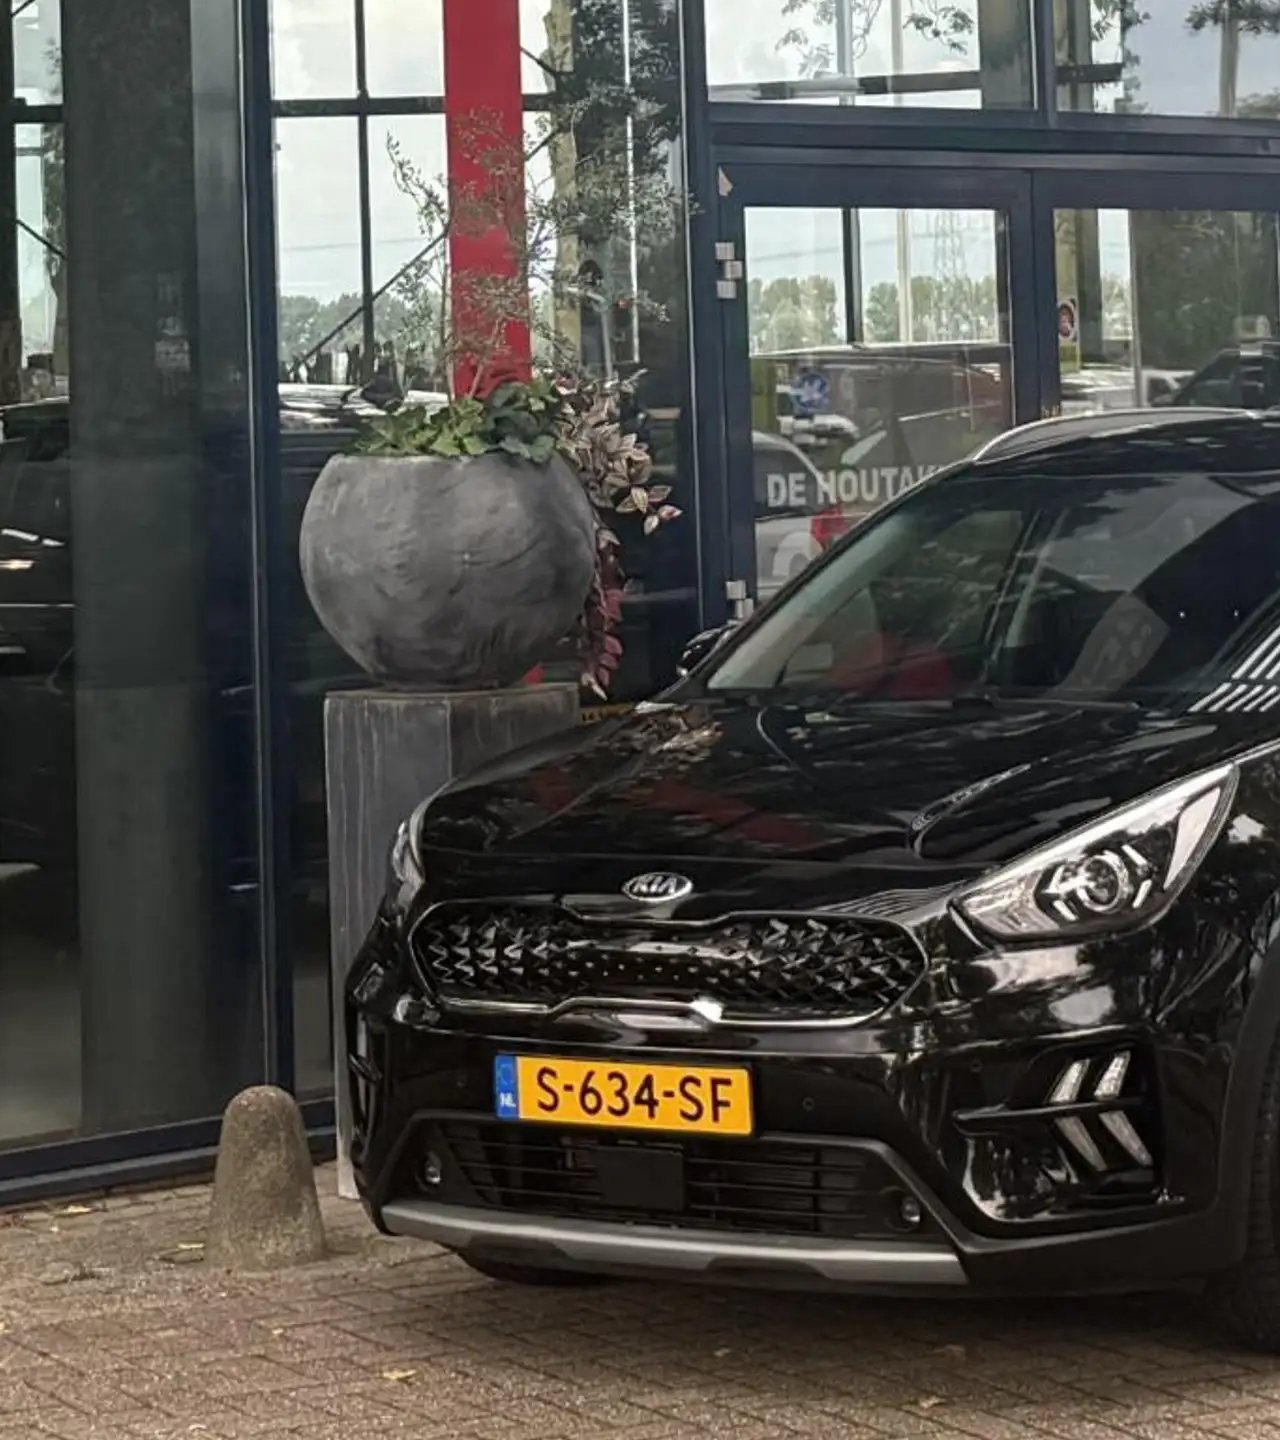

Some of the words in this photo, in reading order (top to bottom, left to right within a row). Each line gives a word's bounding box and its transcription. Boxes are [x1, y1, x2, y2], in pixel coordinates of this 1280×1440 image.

[768, 472, 806, 507] DE
[499, 1092, 517, 1108] NL
[535, 1065, 733, 1124] S-634-SF
